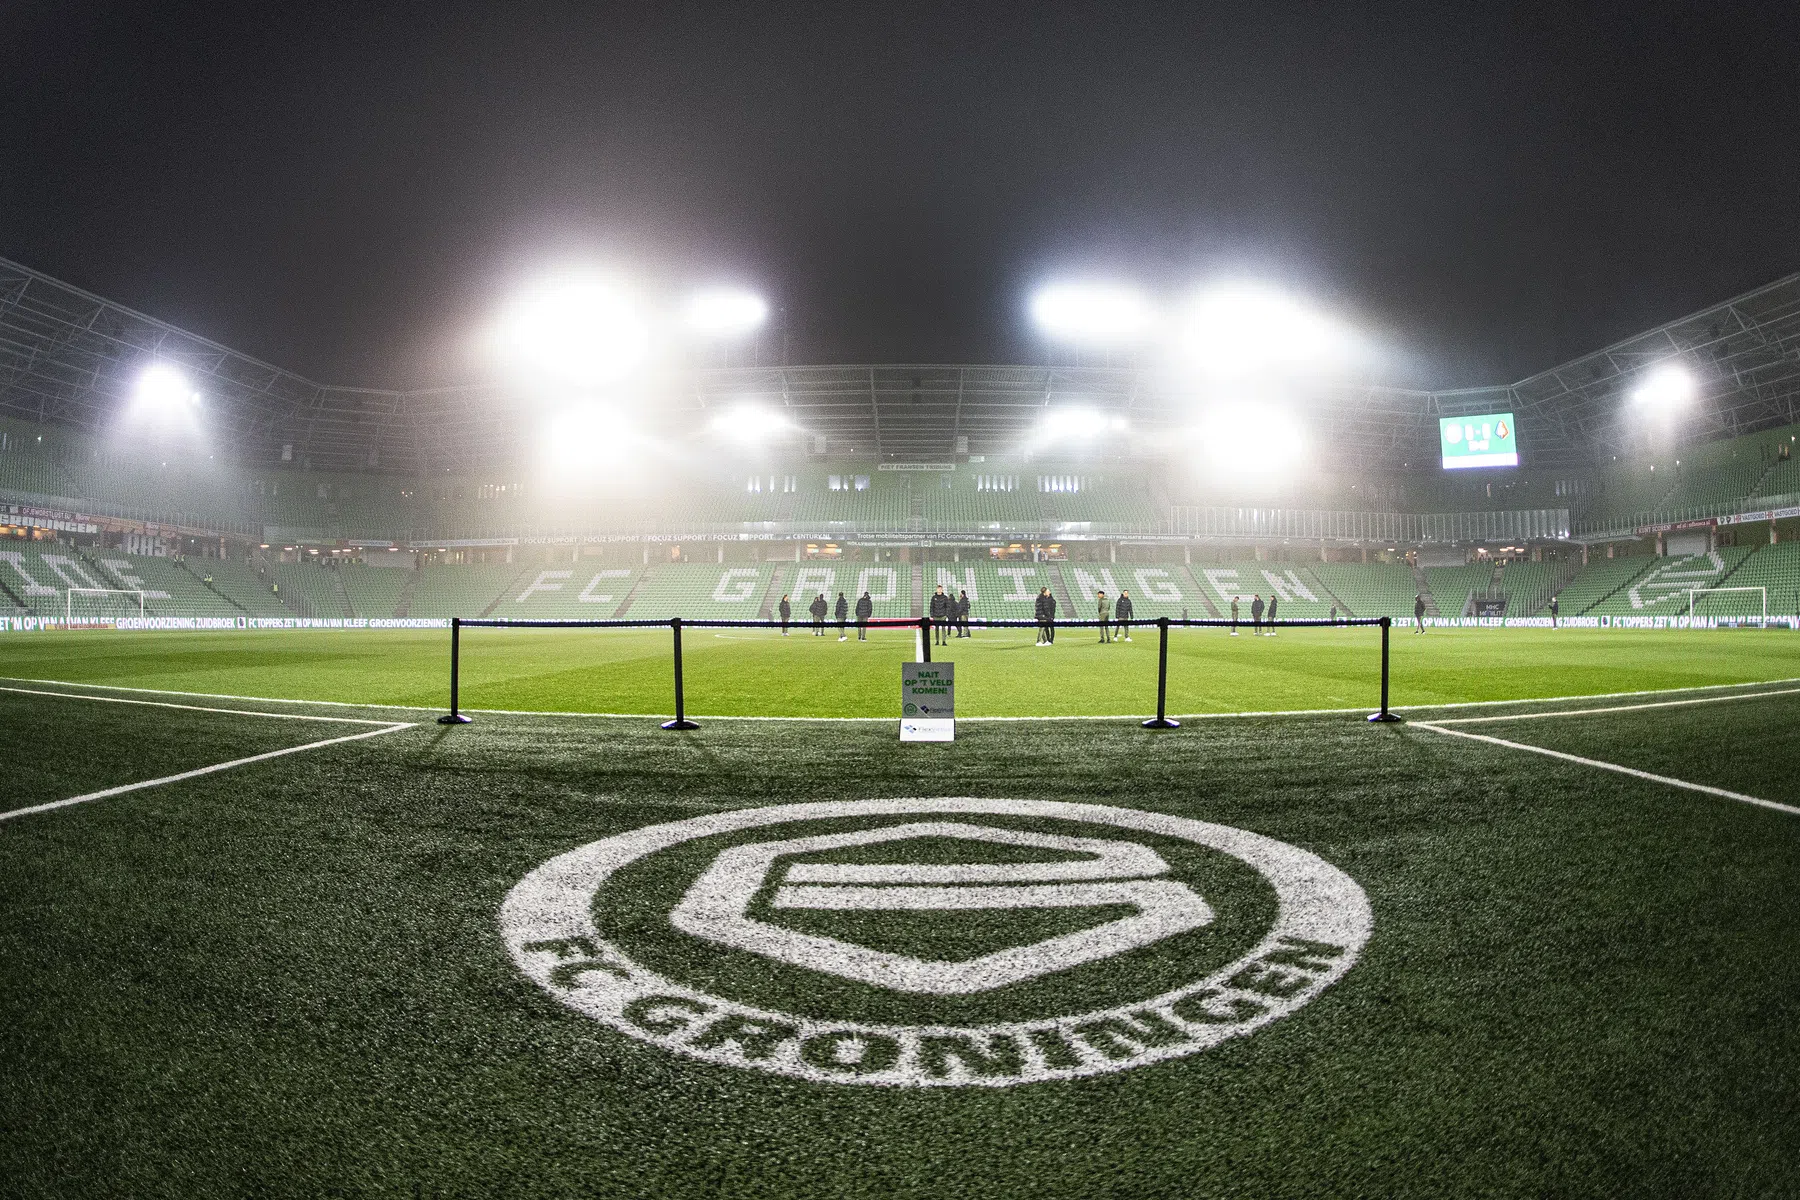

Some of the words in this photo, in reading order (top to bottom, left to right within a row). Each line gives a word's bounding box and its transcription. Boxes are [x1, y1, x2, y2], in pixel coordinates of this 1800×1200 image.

[1766, 511, 1774, 519] HR
[876, 532, 925, 540] mobiliteitspartner
[516, 569, 631, 603] FC
[711, 567, 1319, 603] GRONINGEN
[23, 616, 38, 630] OP
[116, 617, 195, 629] GROENVOORZIENING
[195, 617, 235, 629] ZUIDBROEK
[248, 617, 257, 628] FC
[257, 617, 284, 628] TOPPERS
[284, 617, 295, 628] ZET
[302, 617, 312, 628] OP
[312, 617, 323, 628] VAN
[323, 618, 330, 628] AJ
[330, 618, 342, 628] VAN
[343, 618, 368, 628] KLEEF
[369, 618, 447, 628] GROENVOORZIENING
[1397, 617, 1411, 627] ZET
[1422, 617, 1434, 627] OP
[1434, 617, 1449, 627] VAN
[1449, 617, 1460, 627] AJ
[1460, 617, 1478, 627] VAN
[1479, 617, 1503, 627] KLEEF
[1563, 617, 1599, 627] ZUIDBROEK
[1612, 616, 1622, 628] FC
[1622, 616, 1654, 628] TOPPERS
[1654, 616, 1668, 628] ZET
[1668, 616, 1678, 628] 'M
[1678, 616, 1690, 628] OP
[1690, 616, 1707, 628] VAN
[1708, 616, 1718, 628] AJ
[521, 935, 631, 989] FC
[622, 936, 1345, 1078] GRONINGEN
